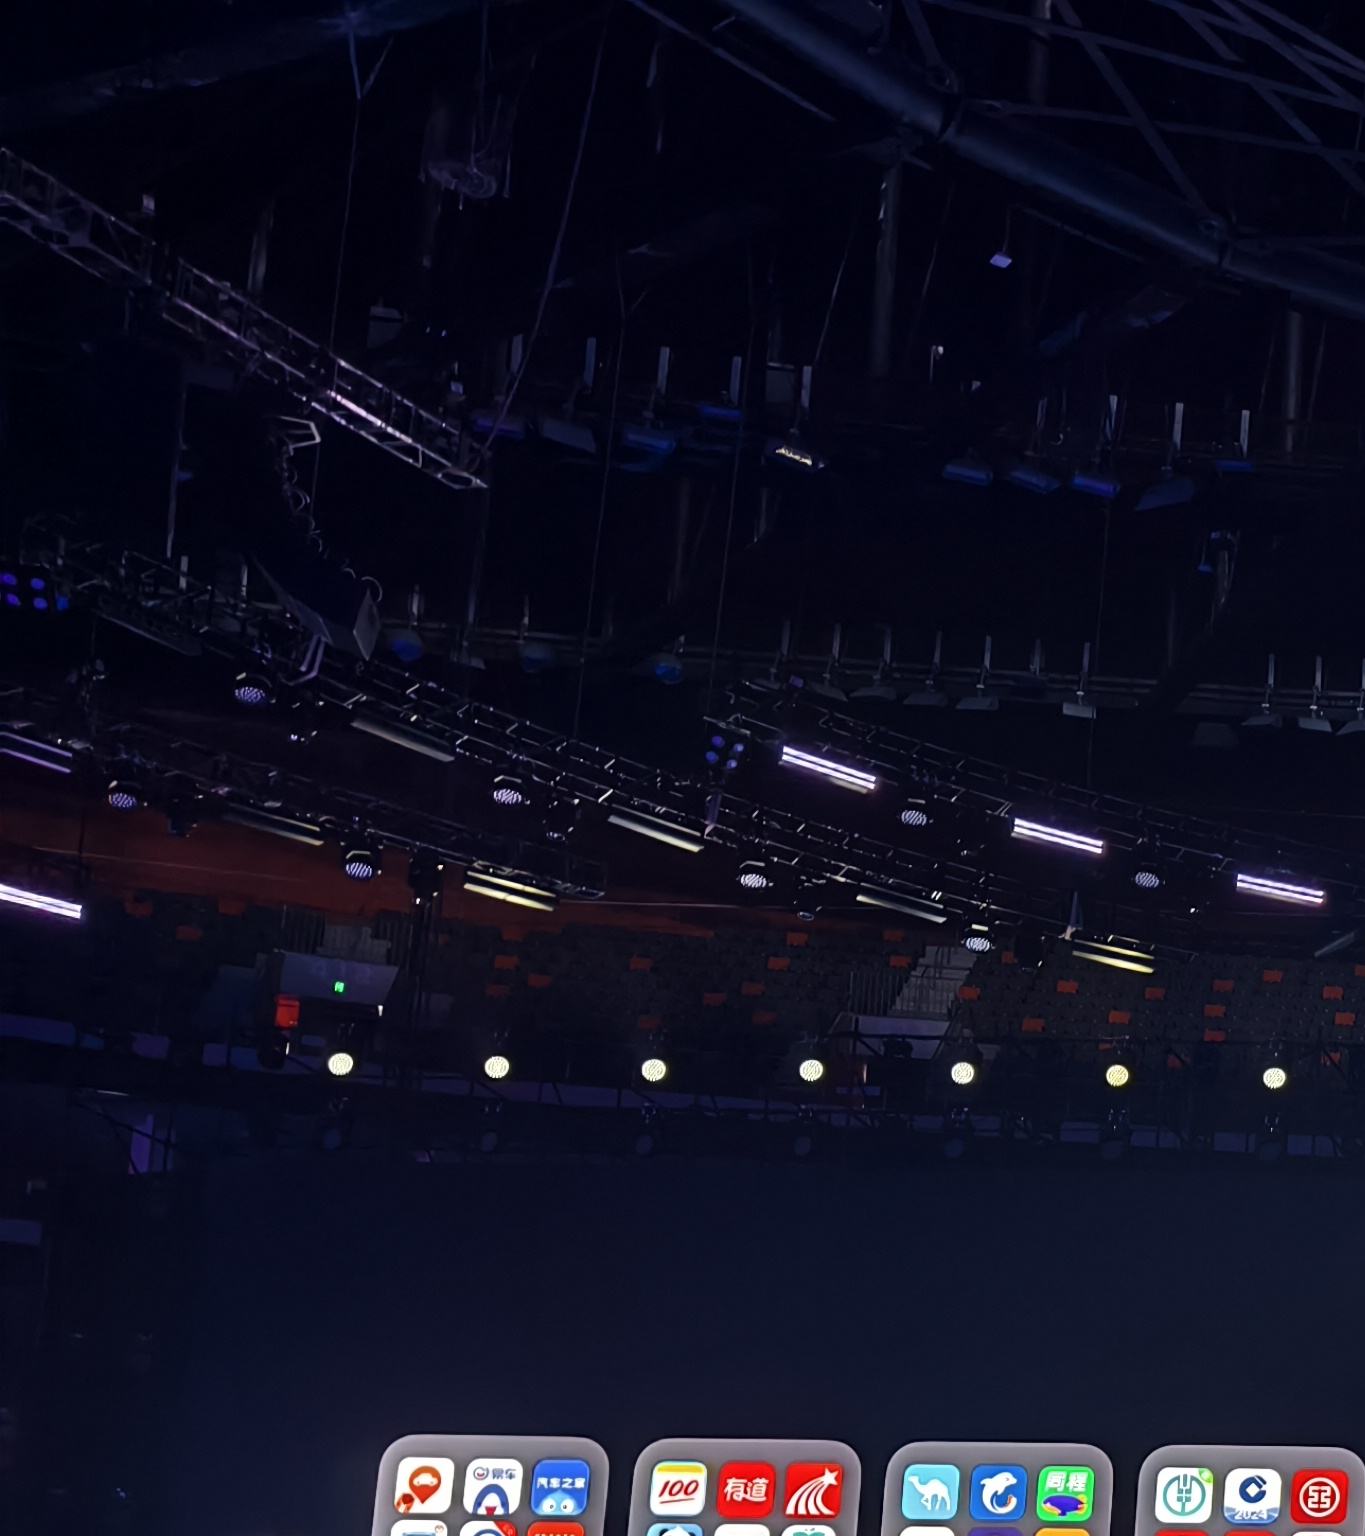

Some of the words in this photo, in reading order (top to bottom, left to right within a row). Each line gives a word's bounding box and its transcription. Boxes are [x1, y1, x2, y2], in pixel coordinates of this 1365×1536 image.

[536, 1477, 586, 1488] 汽车之家
[658, 1479, 699, 1498] 100
[724, 1477, 769, 1502] 有道
[1045, 1472, 1088, 1492] 同程
